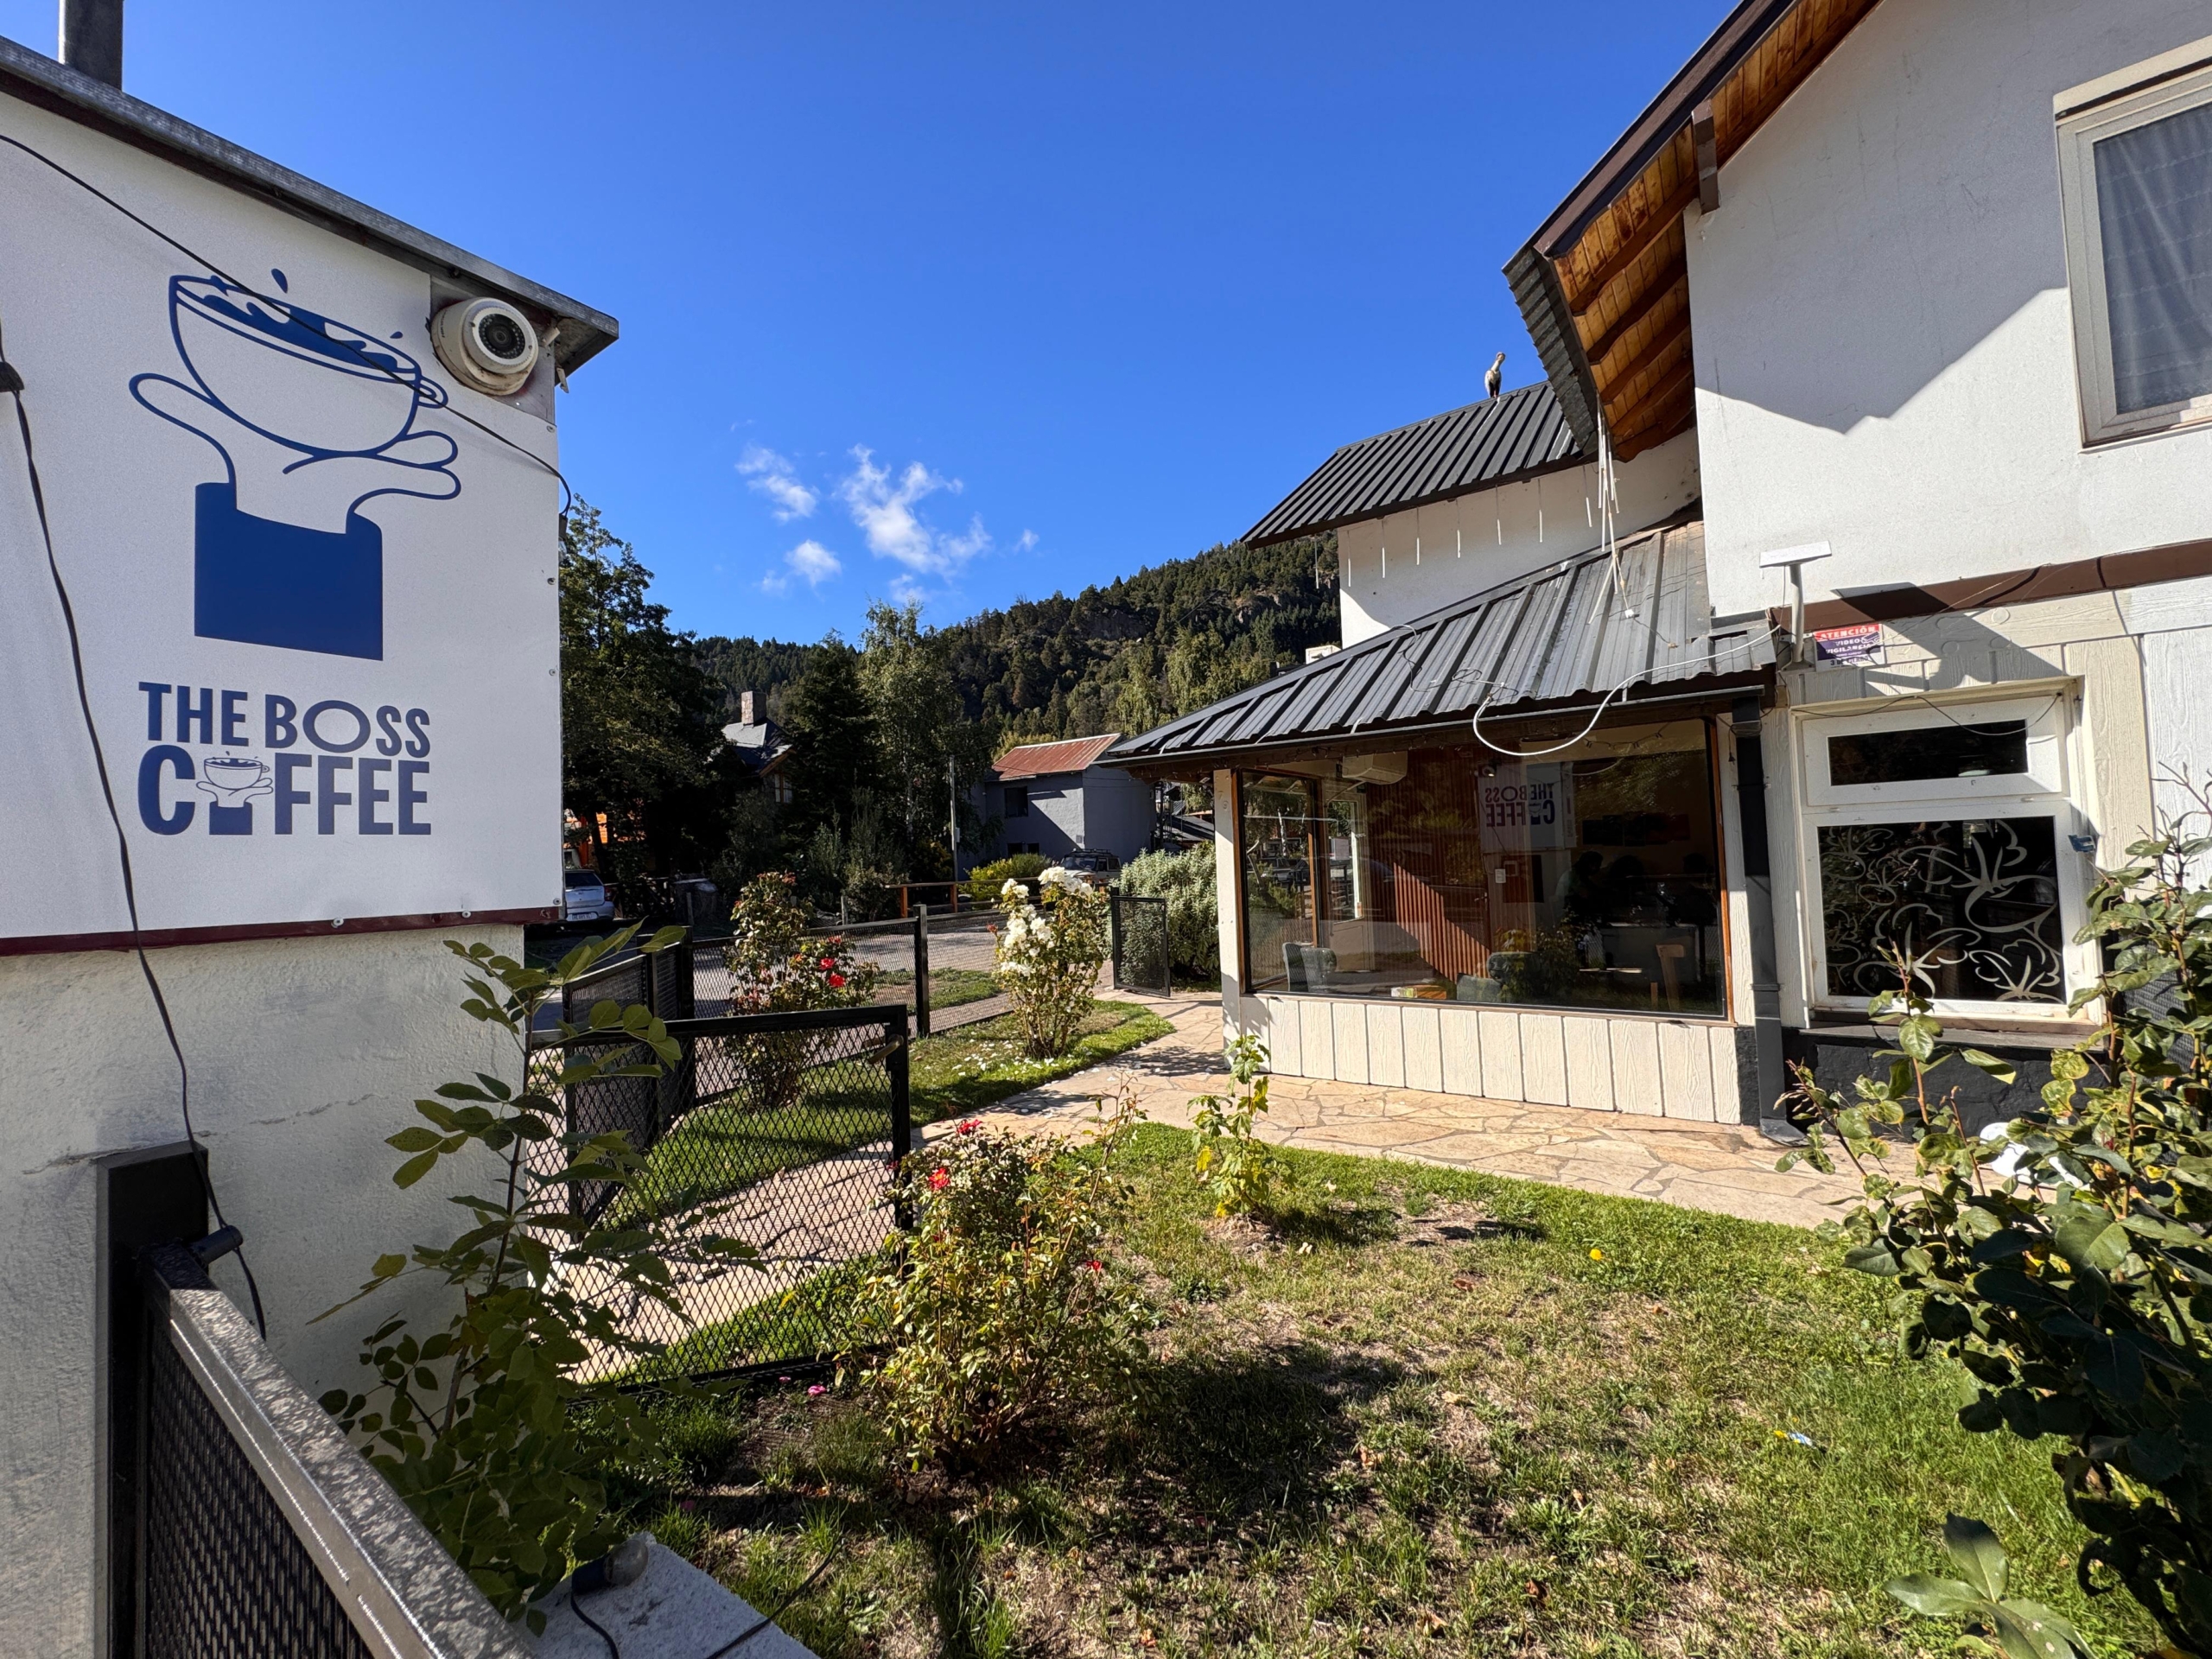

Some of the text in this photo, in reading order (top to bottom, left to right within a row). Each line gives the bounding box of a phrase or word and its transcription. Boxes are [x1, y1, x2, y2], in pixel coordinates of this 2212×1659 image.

[1821, 626, 1875, 639] ATENCIÓN
[138, 682, 431, 759] THE BOSS
[137, 744, 431, 836] CFFEE
